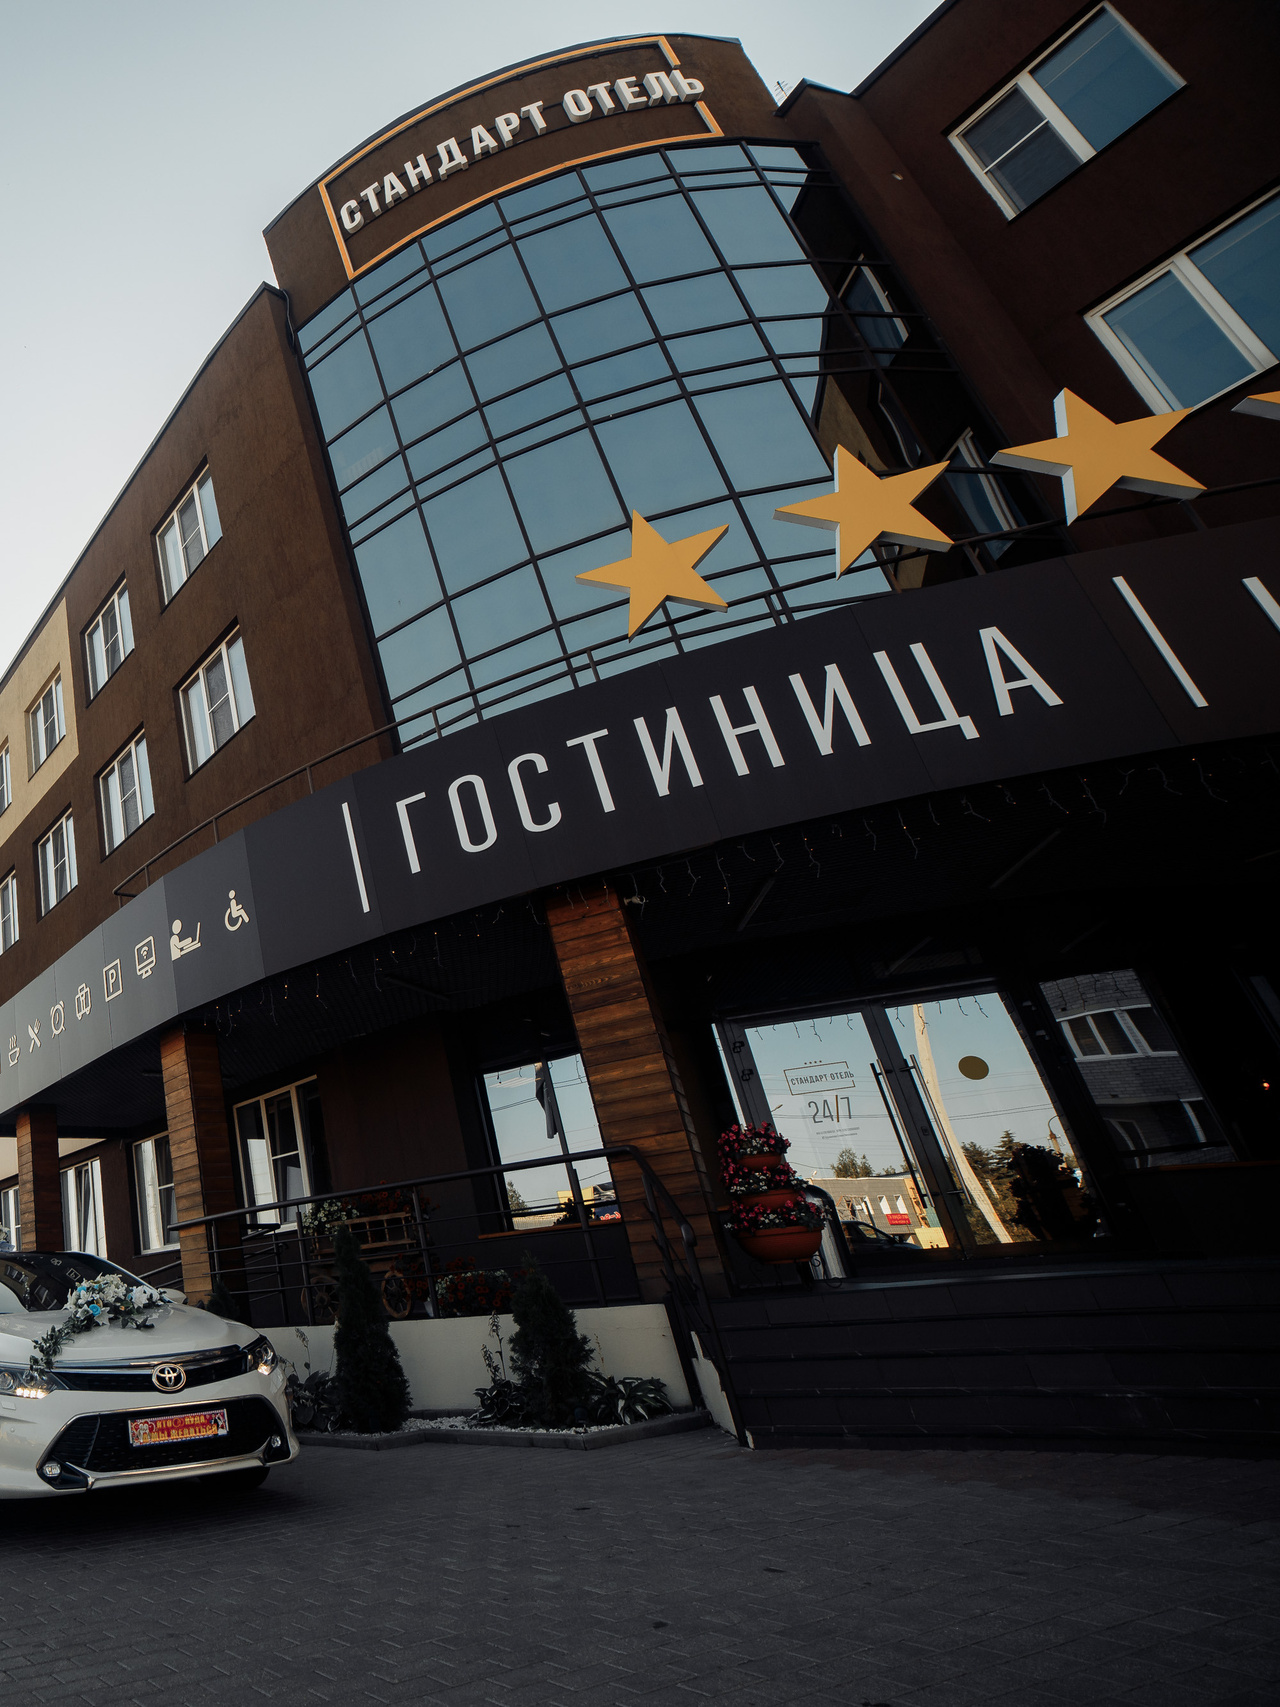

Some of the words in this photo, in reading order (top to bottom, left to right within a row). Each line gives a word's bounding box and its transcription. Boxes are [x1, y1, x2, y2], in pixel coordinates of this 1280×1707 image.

[340, 101, 547, 234] СТАНДАРТ
[563, 69, 705, 123] ОТЕЛЬ
[395, 626, 1063, 874] ГОСТИНИЦА
[790, 1074, 827, 1086] СТАНДАРТ
[829, 1071, 855, 1081] ОТЕЛЬ
